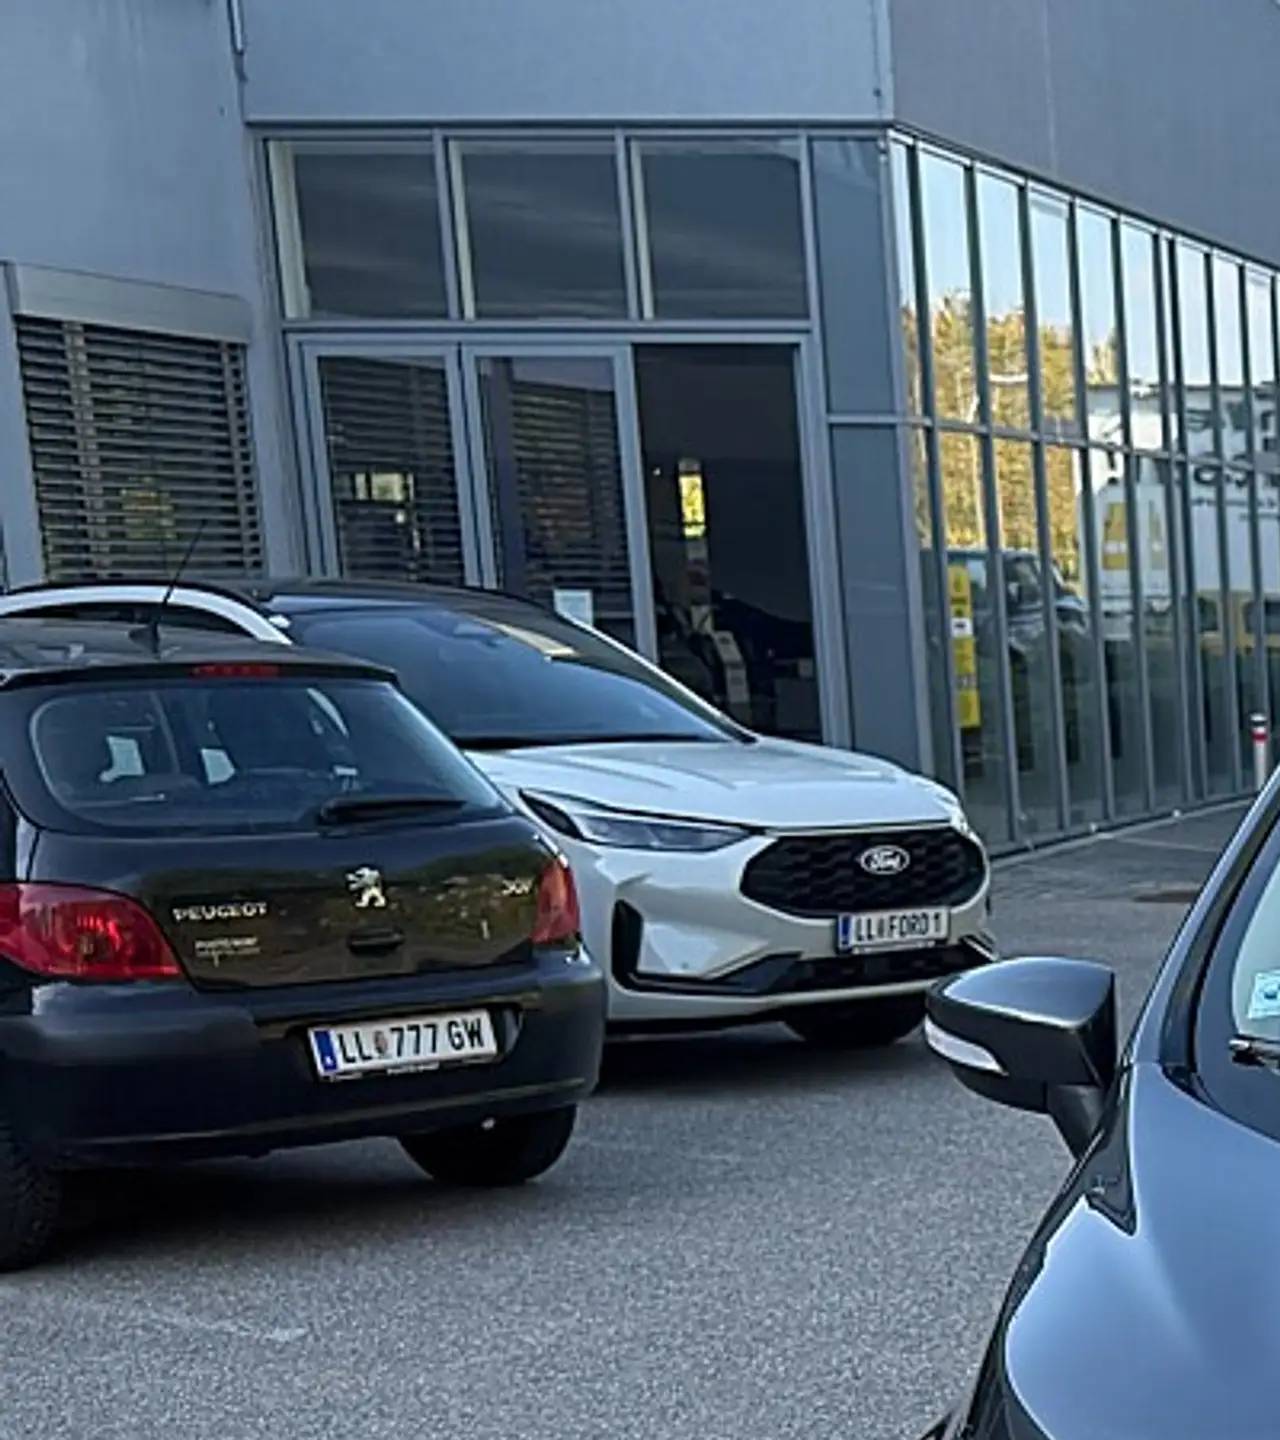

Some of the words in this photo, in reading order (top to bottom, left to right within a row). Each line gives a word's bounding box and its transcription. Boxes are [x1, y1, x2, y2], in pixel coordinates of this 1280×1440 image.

[338, 1030, 373, 1063] LL
[390, 1023, 439, 1057] 777
[447, 1017, 484, 1051] GW
